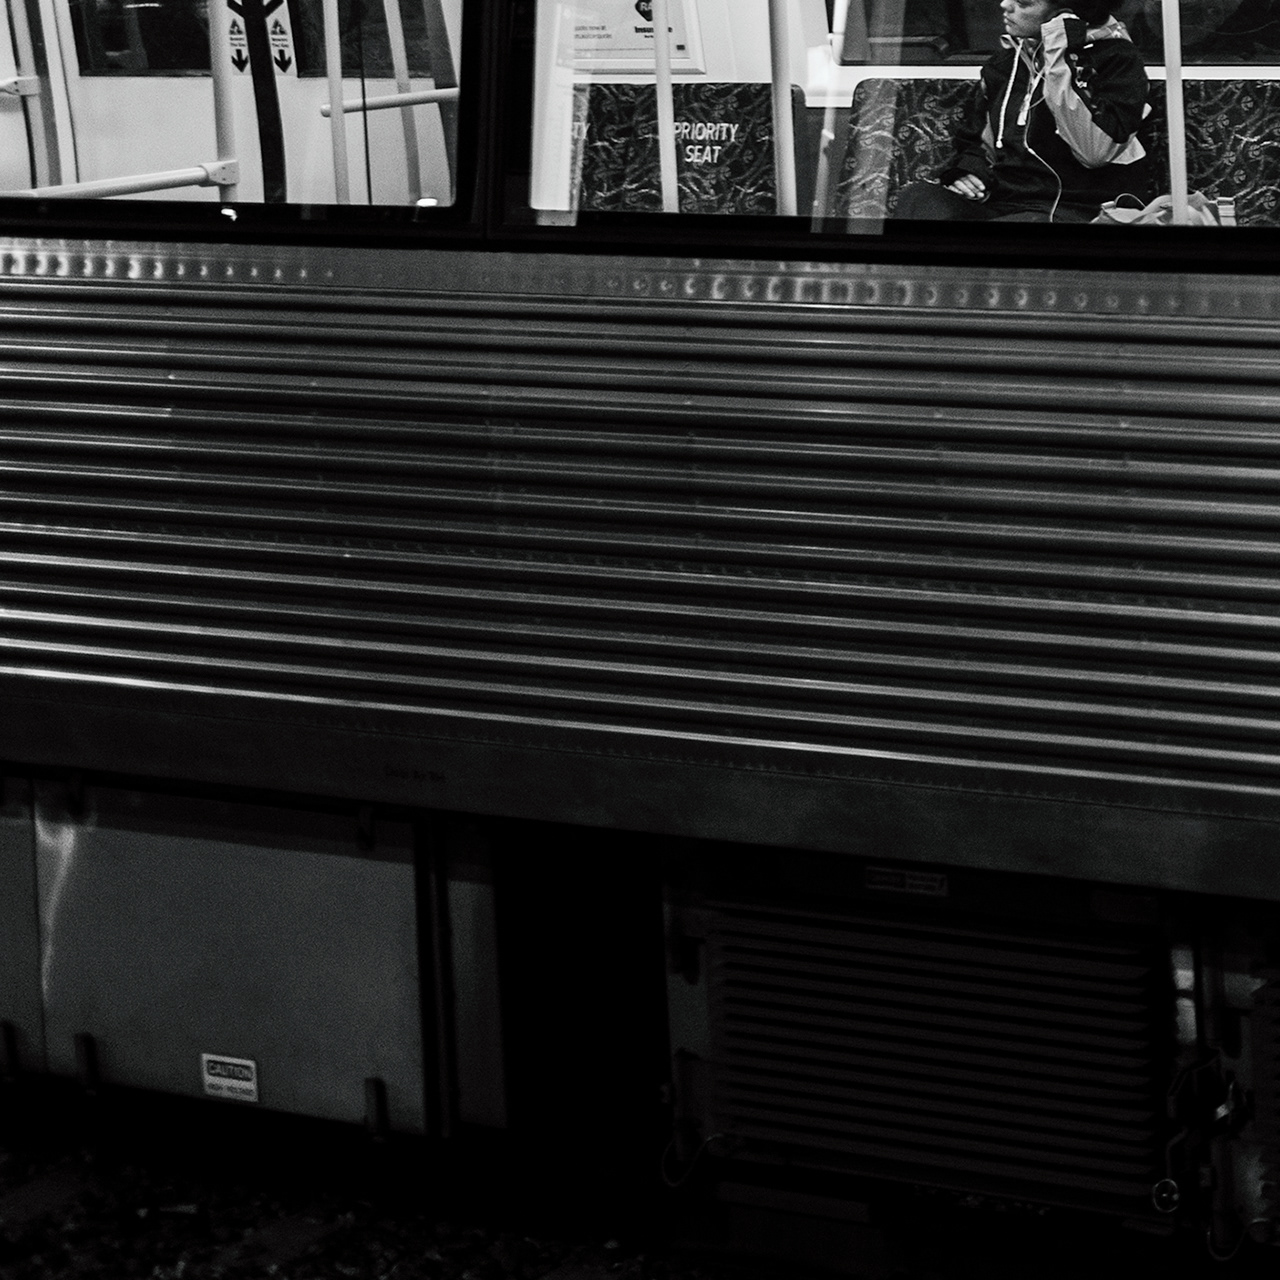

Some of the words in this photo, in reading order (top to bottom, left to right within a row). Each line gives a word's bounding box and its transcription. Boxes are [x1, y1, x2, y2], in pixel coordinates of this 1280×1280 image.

[674, 122, 739, 142] PRIORITY
[684, 145, 722, 163] SEAT
[207, 1062, 254, 1080] CAUTION
